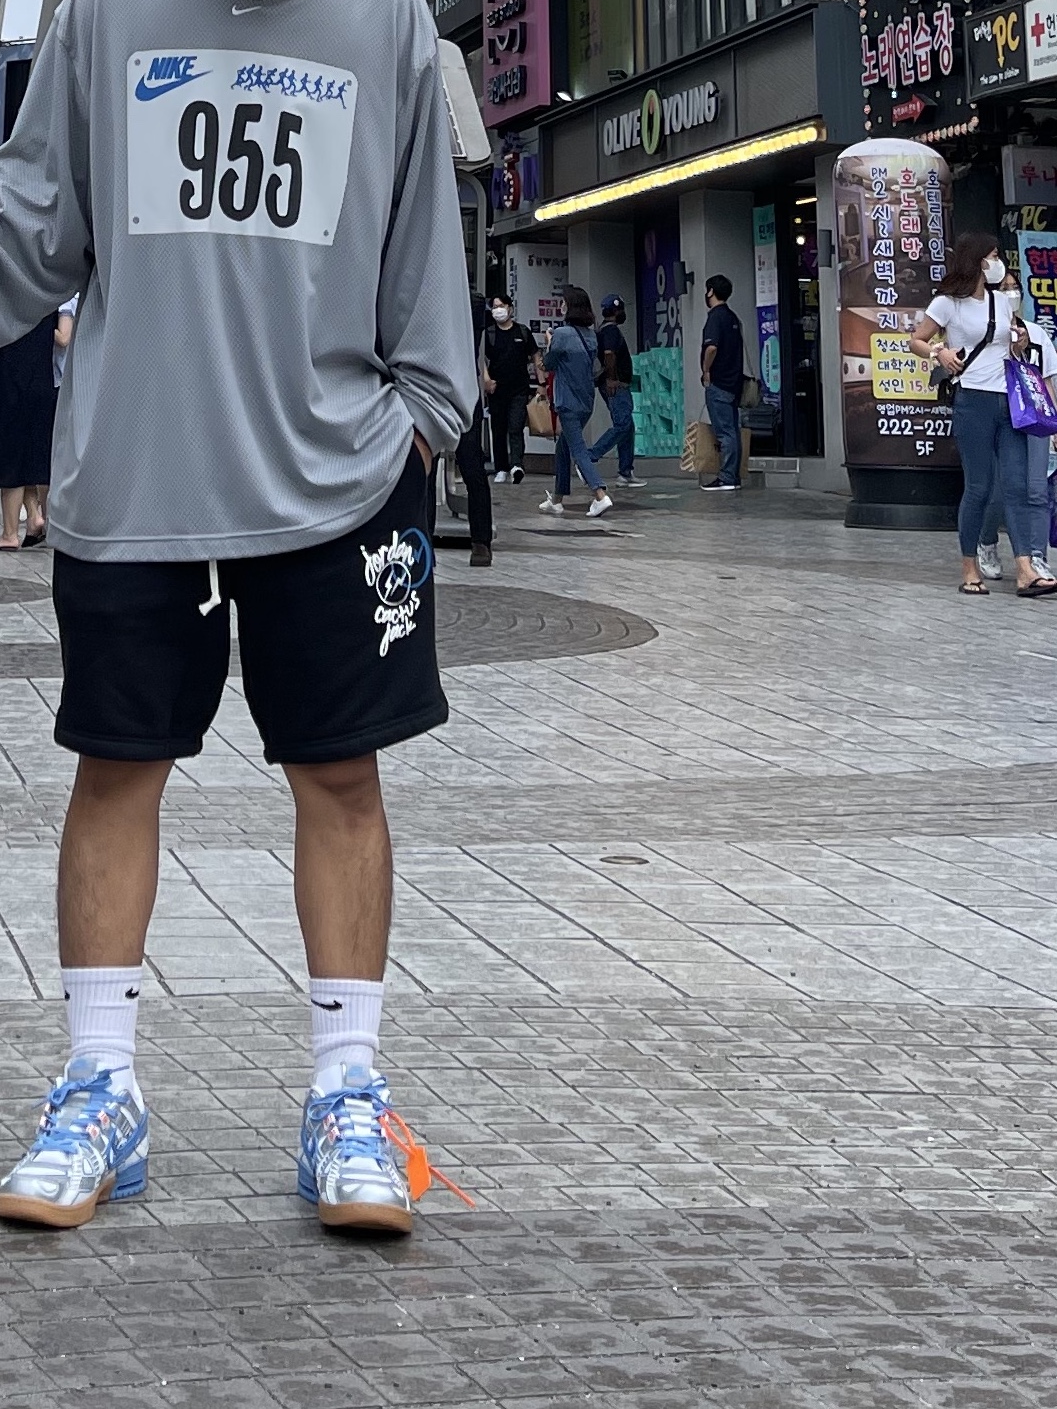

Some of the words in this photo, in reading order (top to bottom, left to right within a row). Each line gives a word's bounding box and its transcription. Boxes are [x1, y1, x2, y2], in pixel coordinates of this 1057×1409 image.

[1046, 13, 1057, 39] 헌
[861, 1, 955, 89] 노래연습장
[147, 56, 198, 81] NIKE
[603, 106, 641, 156] OLIVE
[662, 81, 721, 133] YOUNG
[178, 100, 304, 228] 955
[926, 169, 947, 282] 호텔식인테
[877, 357, 917, 374] 대학생
[878, 378, 905, 394] 성인
[915, 440, 935, 456] 5F
